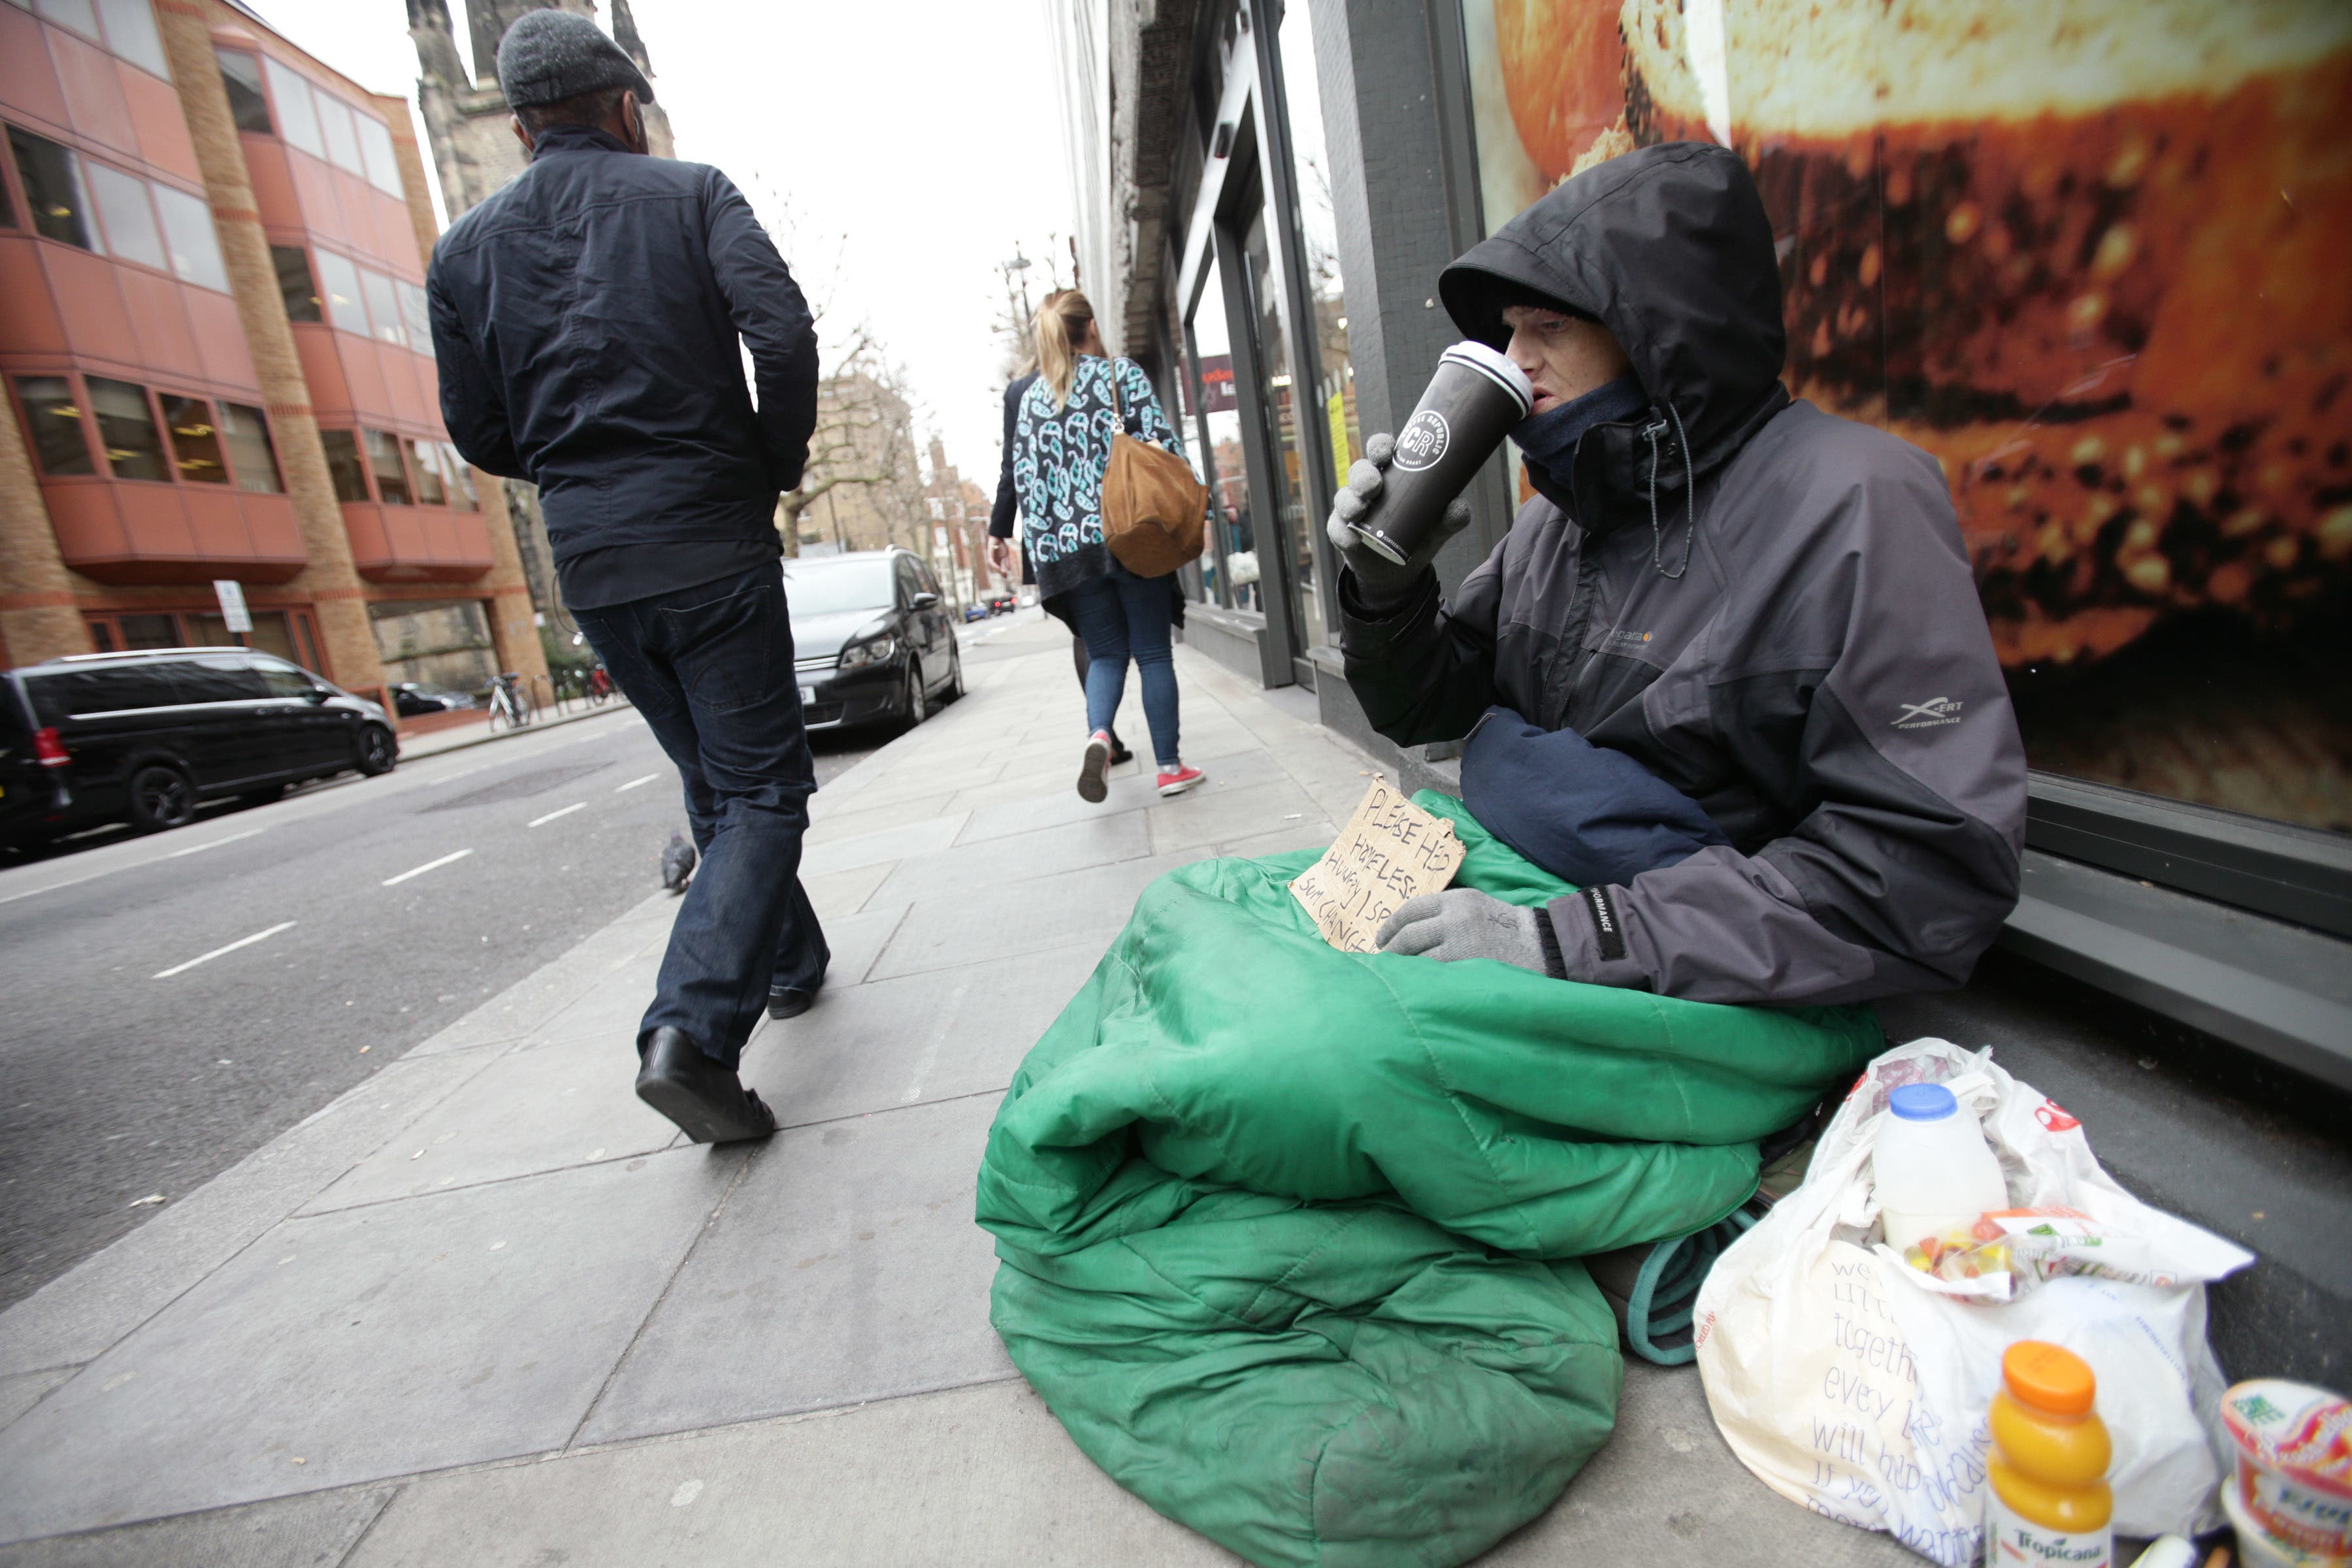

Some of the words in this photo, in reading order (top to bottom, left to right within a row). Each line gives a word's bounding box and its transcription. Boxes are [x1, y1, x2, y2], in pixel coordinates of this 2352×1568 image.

[1403, 427, 1434, 457] CR
[1427, 416, 1445, 455] REPUBLIC
[1899, 717, 1961, 729] PERFORMANCE
[1364, 788, 1422, 844] PLEASE
[1299, 877, 1324, 906] SUM
[1825, 1367, 1894, 1422] every
[1814, 1416, 1865, 1464] will
[2014, 1527, 2101, 1561] Tropicana
